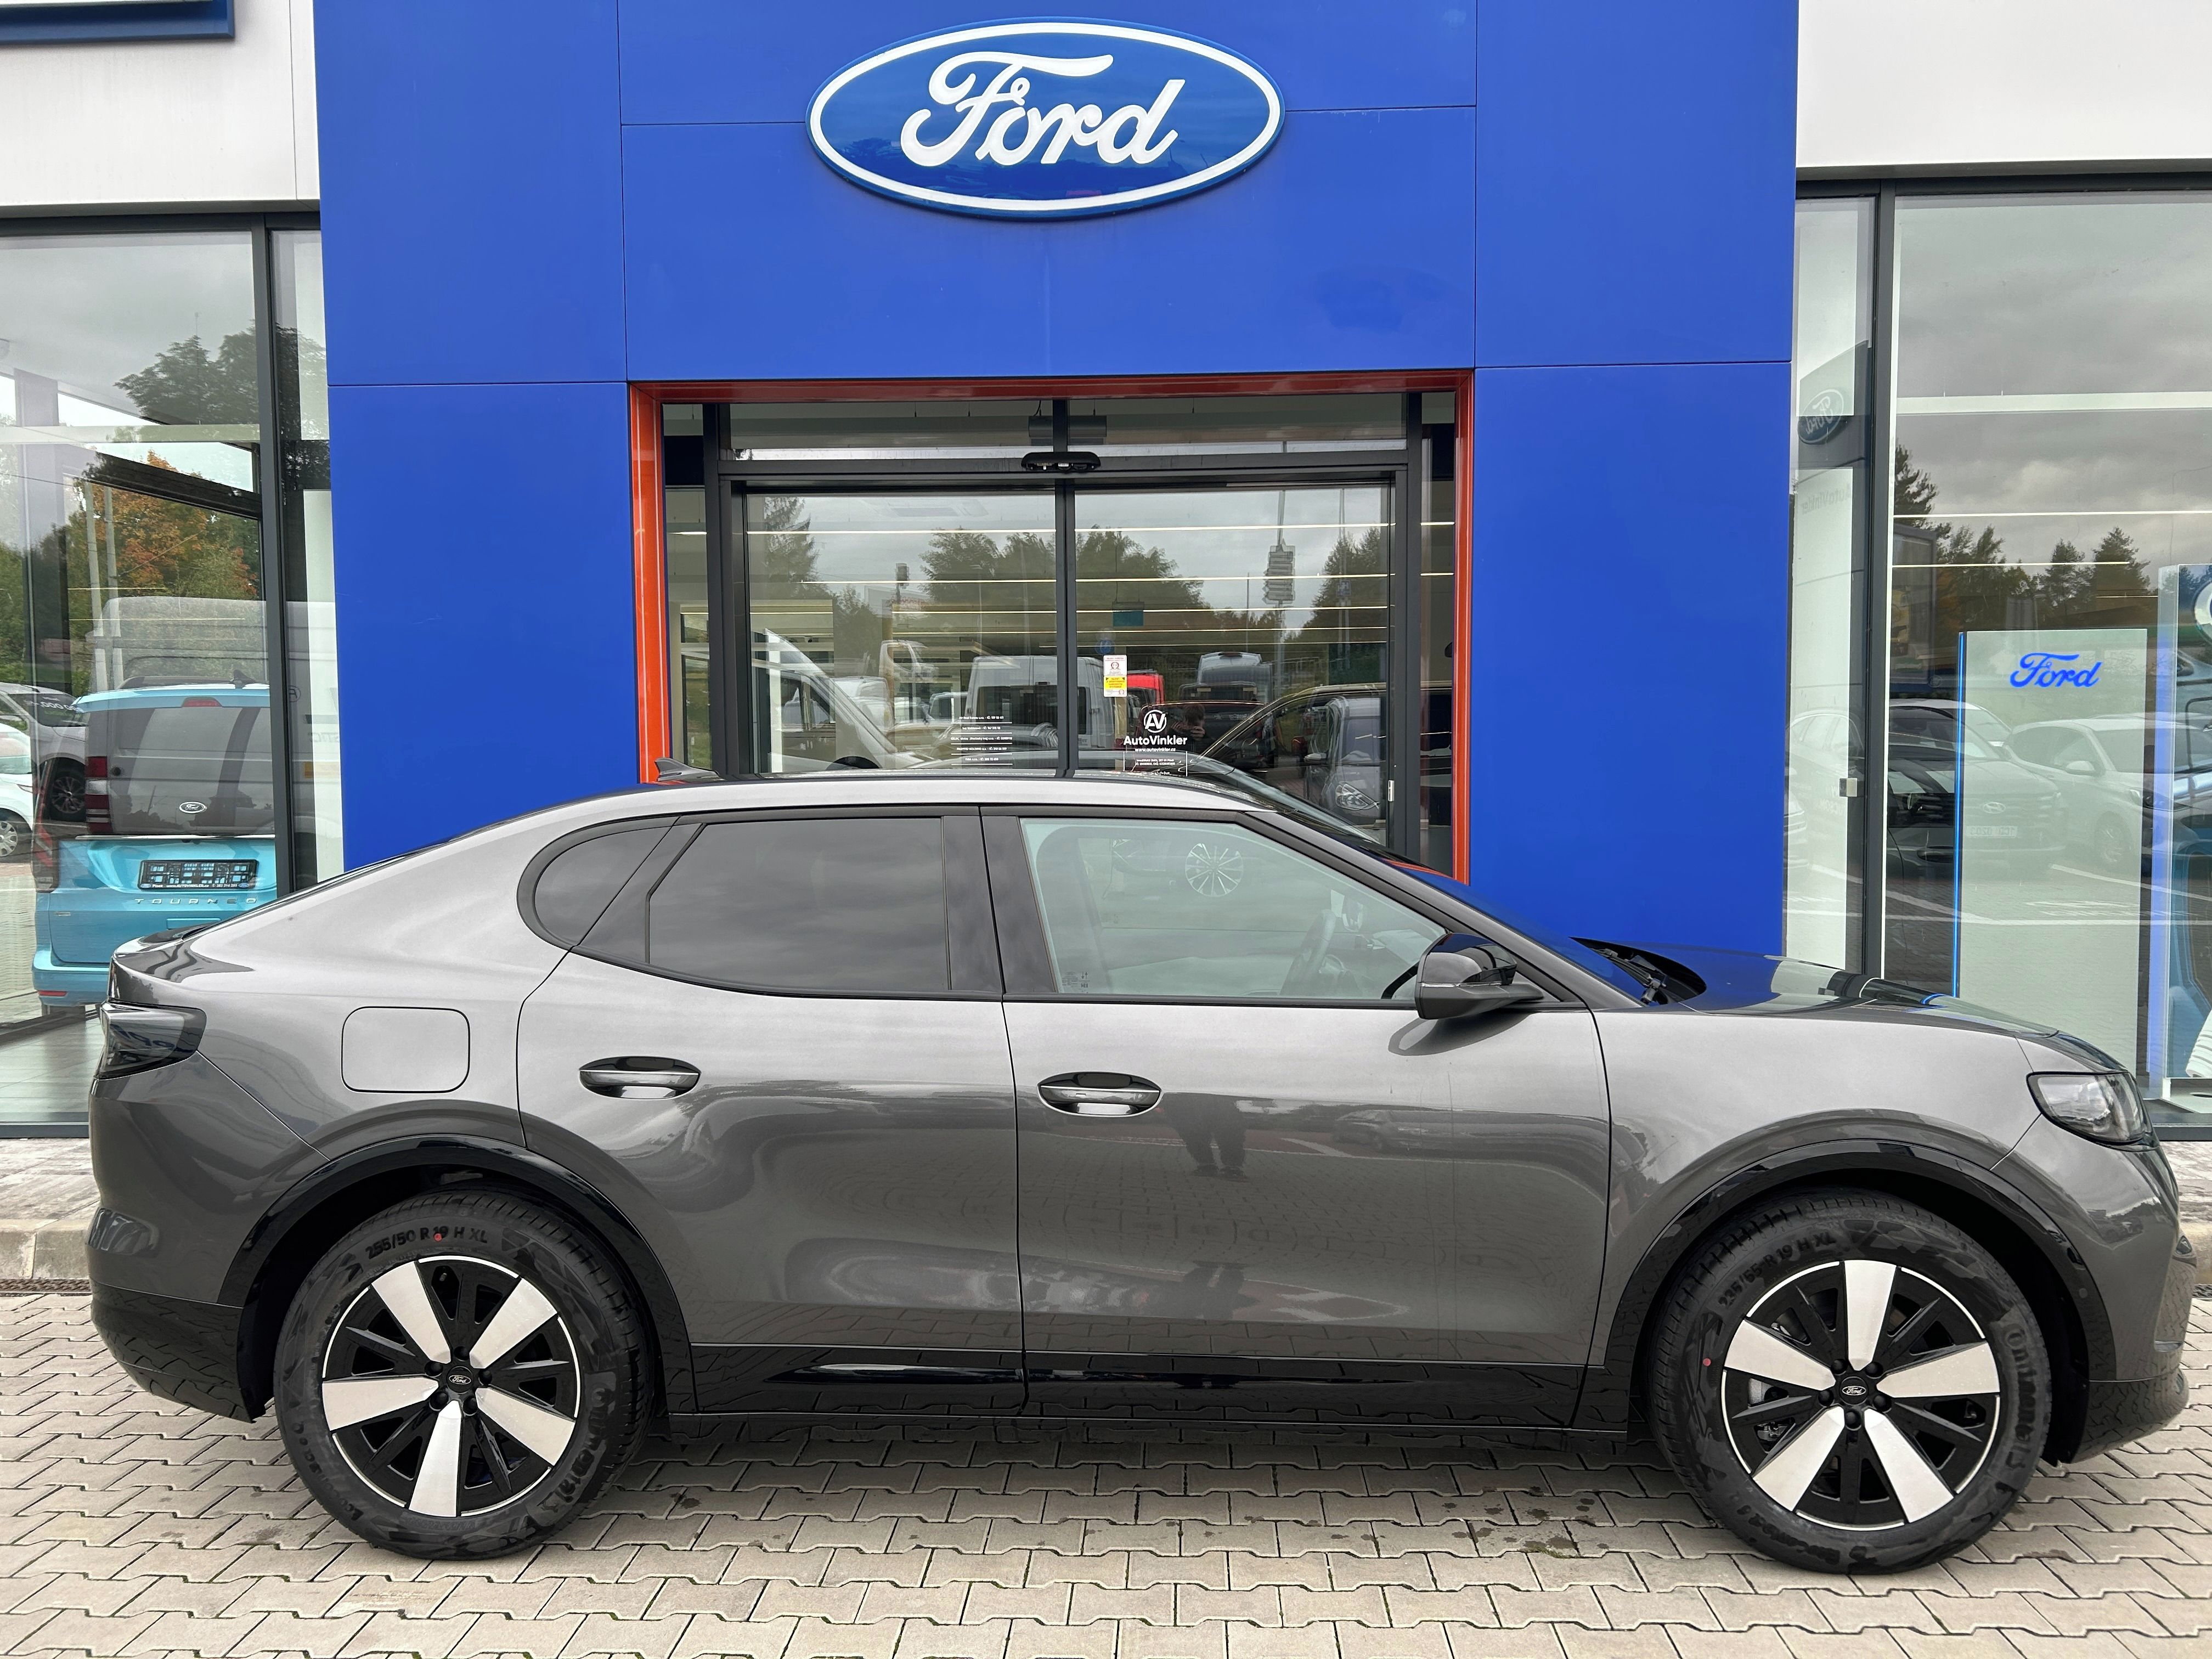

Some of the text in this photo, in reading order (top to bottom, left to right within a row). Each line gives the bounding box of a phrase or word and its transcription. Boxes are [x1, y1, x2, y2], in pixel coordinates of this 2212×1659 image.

[900, 51, 1185, 166] Ford
[2010, 652, 2103, 687] Ford
[1145, 713, 1166, 730] AV
[1123, 735, 1188, 746] AutoVinkler
[365, 1229, 416, 1260] 255/50
[420, 1227, 430, 1240] R
[454, 1226, 465, 1238] H
[469, 1227, 488, 1244] XL
[1776, 1244, 1793, 1260] 19
[1796, 1237, 1811, 1251] H
[1813, 1231, 1837, 1247] XL
